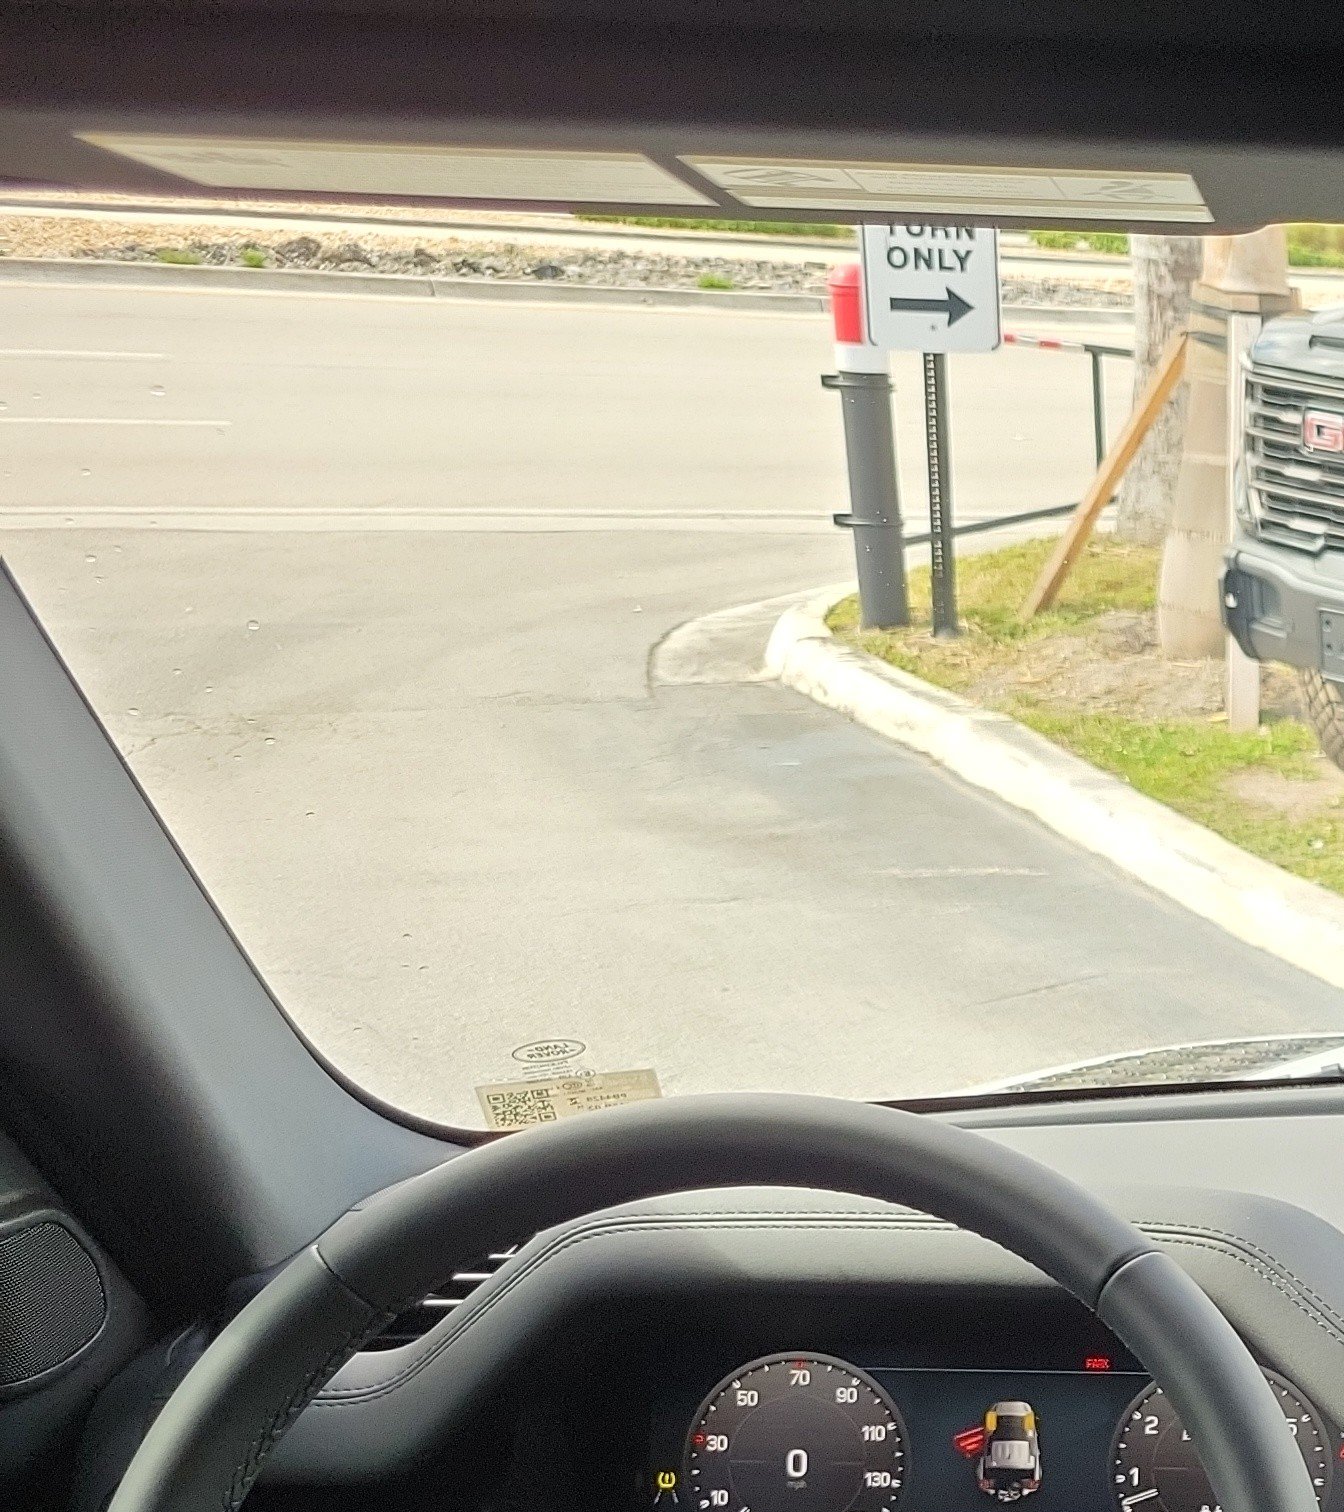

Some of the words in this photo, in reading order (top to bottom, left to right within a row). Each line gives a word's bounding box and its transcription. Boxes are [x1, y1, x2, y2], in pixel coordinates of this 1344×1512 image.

[886, 225, 976, 243] TURN
[886, 246, 972, 273] ONLY
[789, 1370, 810, 1386] 70
[736, 1391, 758, 1406] 50
[836, 1388, 858, 1403] 90
[862, 1426, 886, 1441] 110
[1144, 1416, 1159, 1435] 2
[706, 1435, 728, 1451] 30
[786, 1449, 808, 1478] 0
[865, 1472, 890, 1487] 130
[1129, 1467, 1140, 1486] 1
[711, 1490, 728, 1506] 10
